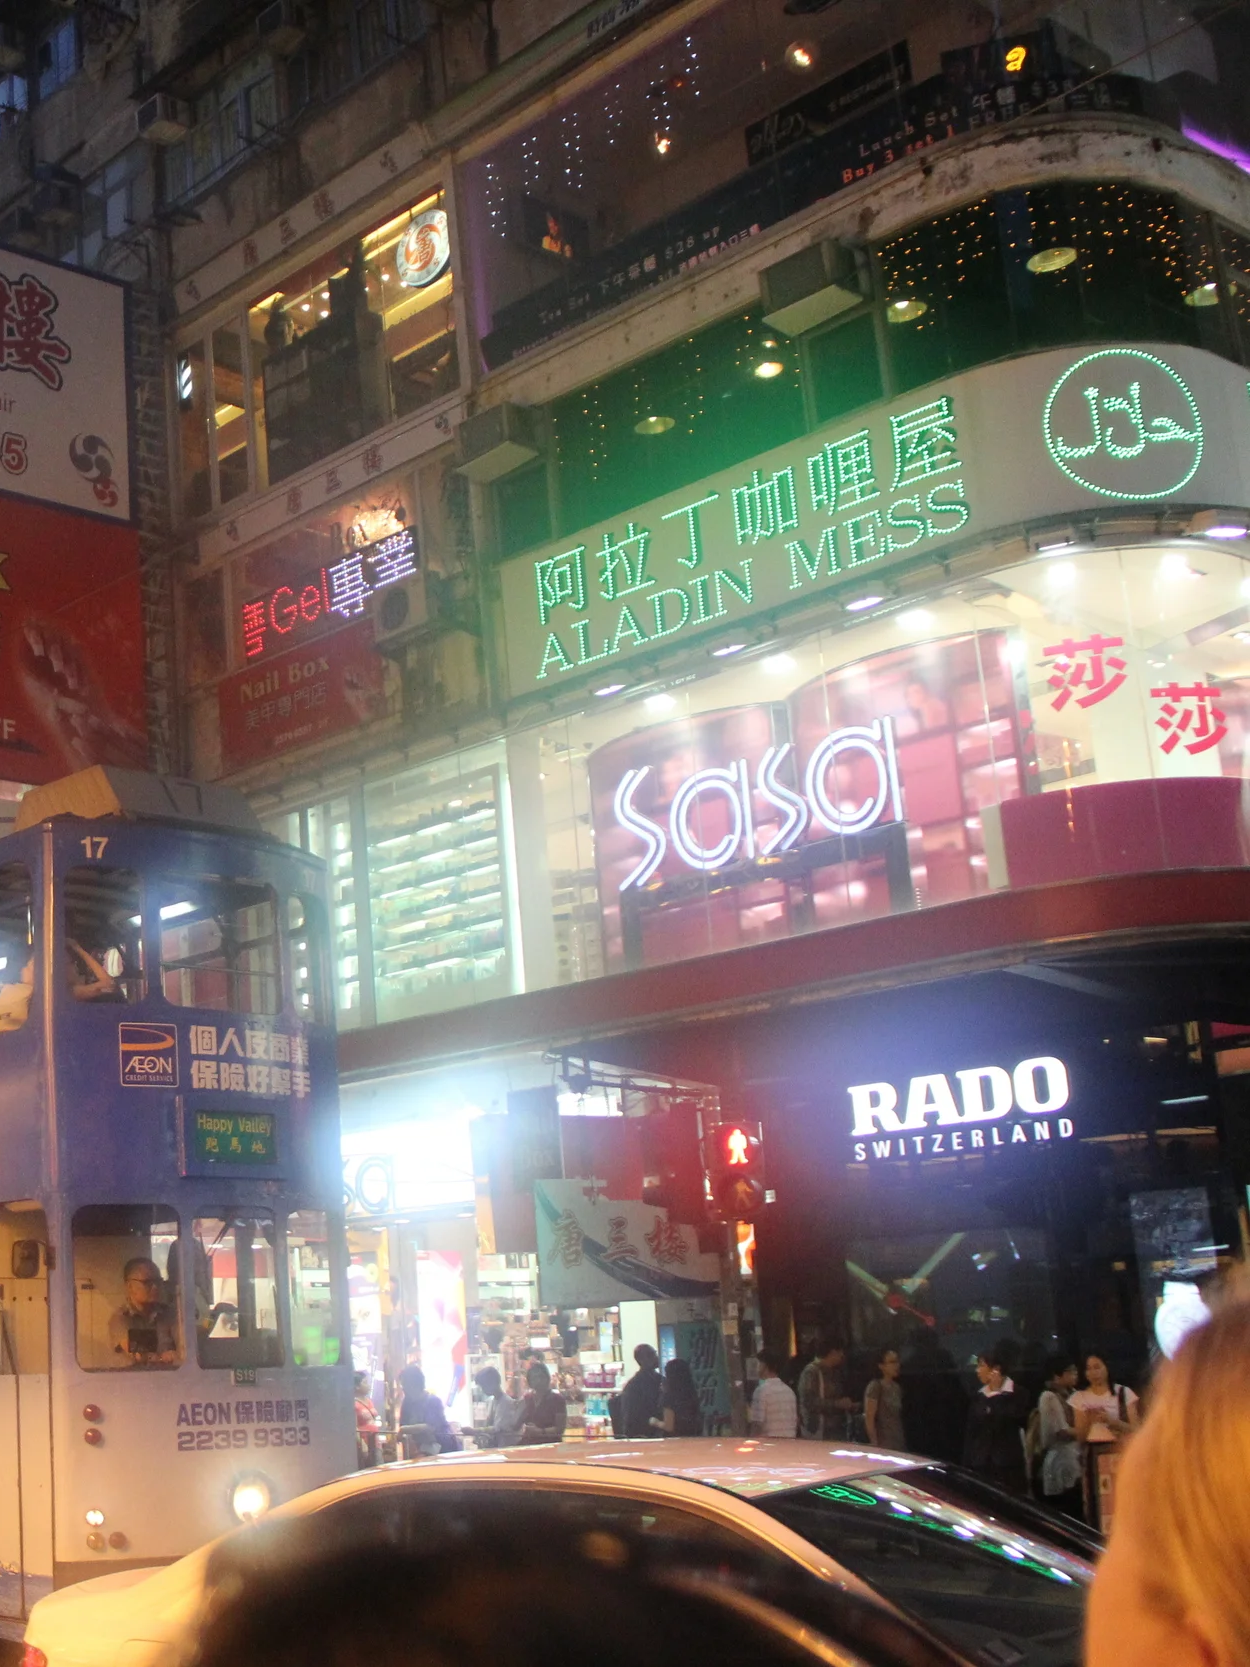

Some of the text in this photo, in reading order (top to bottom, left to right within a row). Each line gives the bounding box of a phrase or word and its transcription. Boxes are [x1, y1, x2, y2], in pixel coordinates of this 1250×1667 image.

[842, 163, 875, 184] Buy
[884, 149, 894, 163] 3
[536, 479, 969, 680] ALADIN MESS
[240, 655, 330, 703] Nail Box
[613, 715, 904, 892] sasa
[81, 836, 109, 859] 17
[125, 1074, 148, 1082] CREDIT
[847, 1056, 1070, 1137] RADO
[197, 1115, 273, 1135] Happy Valley
[854, 1118, 1075, 1161] SWITZERLAND
[205, 1137, 267, 1154] 跑馬地
[176, 1402, 232, 1427] AEON
[177, 1426, 310, 1452] 2239 9333
